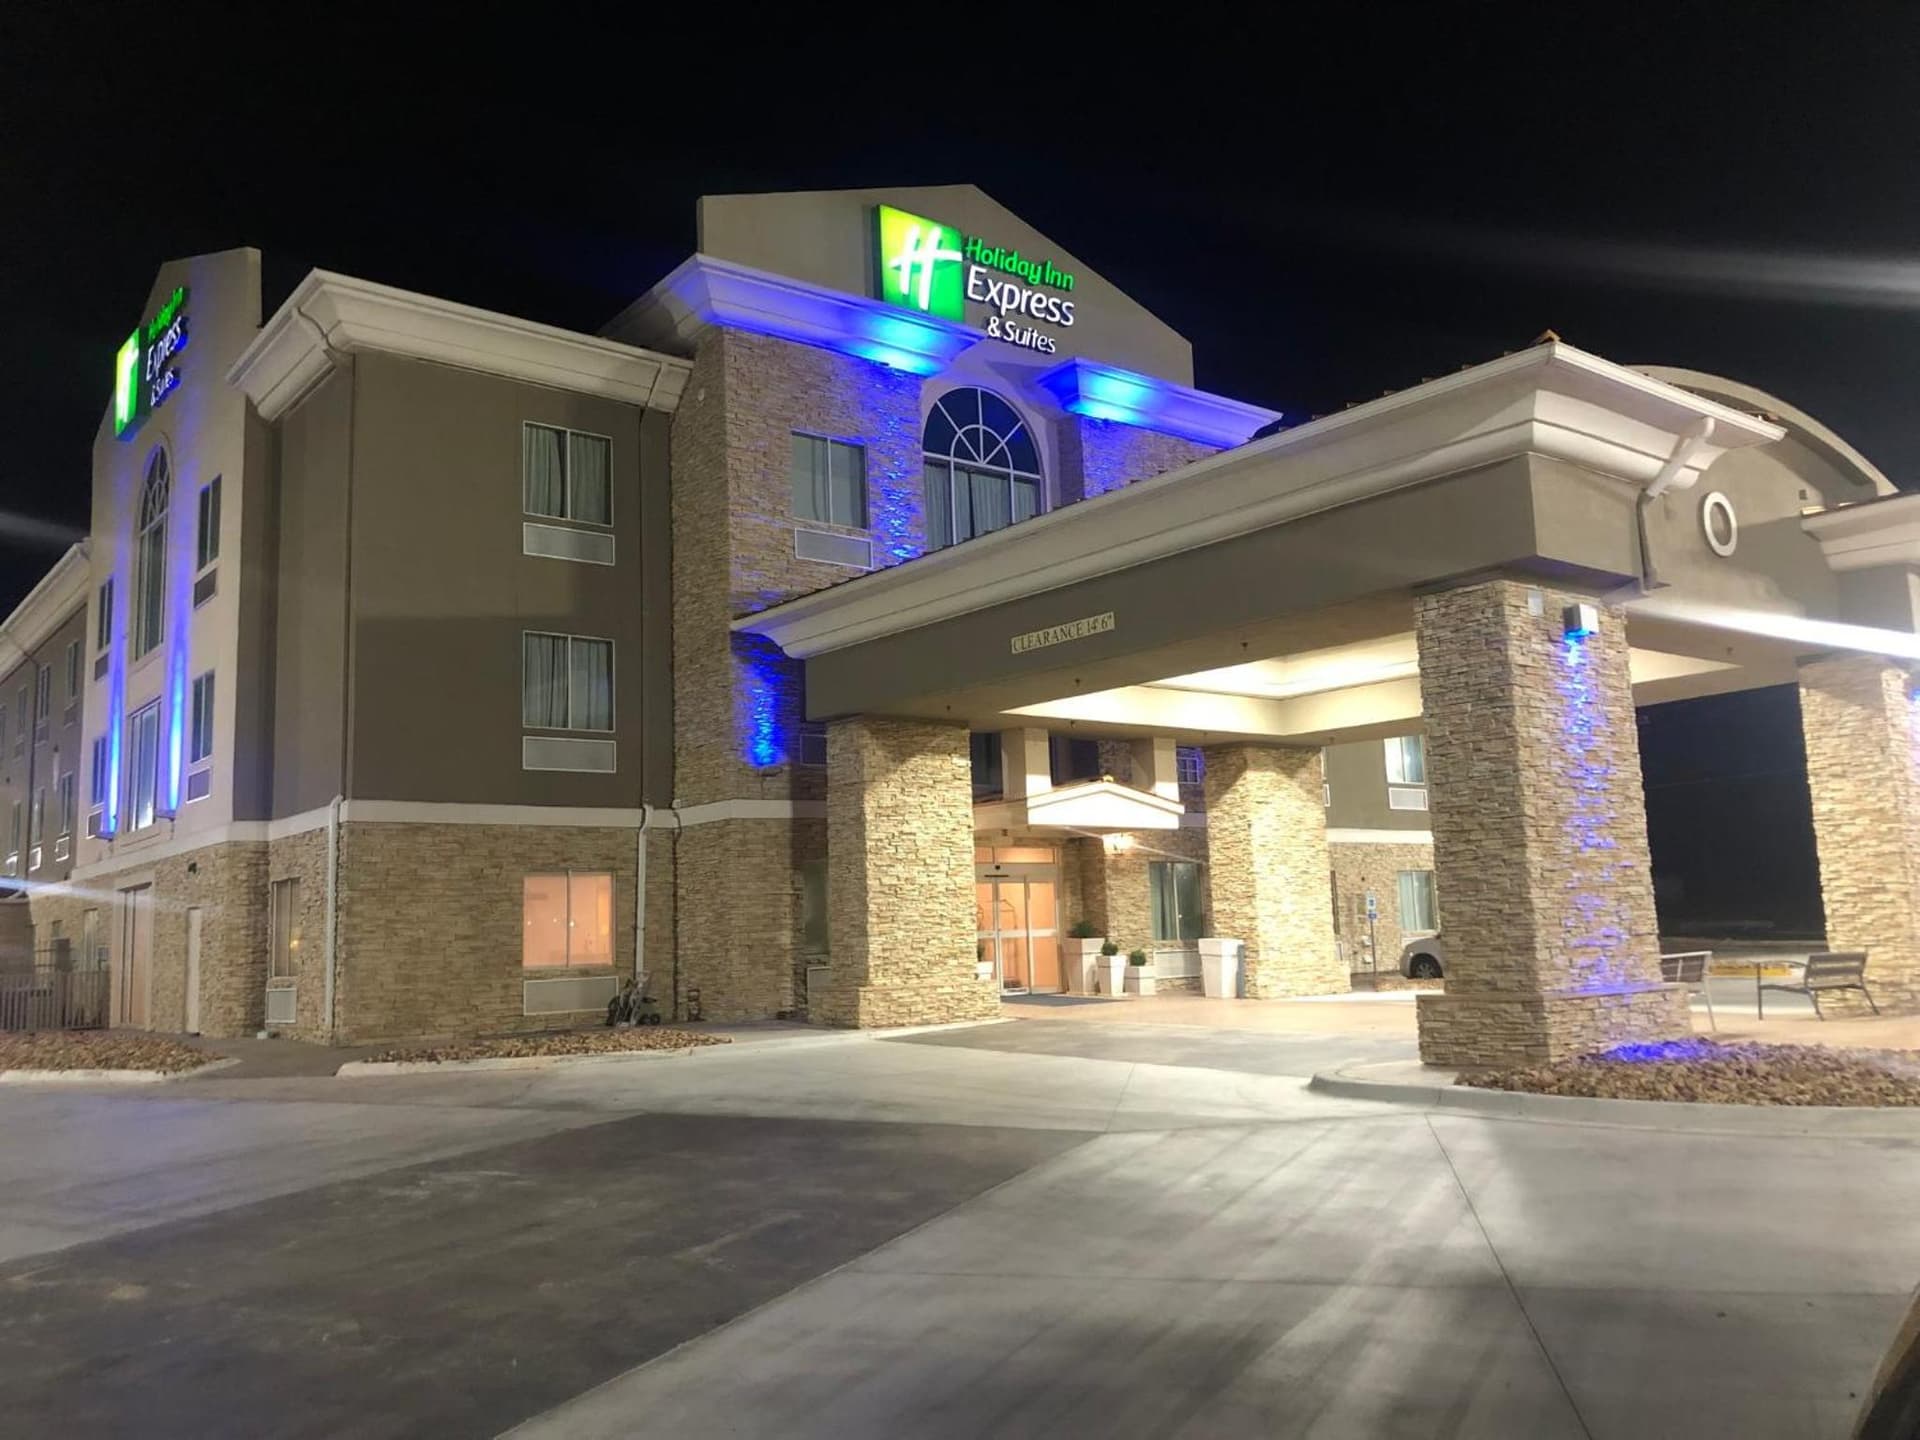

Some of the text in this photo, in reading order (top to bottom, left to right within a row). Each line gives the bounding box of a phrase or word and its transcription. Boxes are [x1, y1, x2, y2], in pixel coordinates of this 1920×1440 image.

[965, 236, 1074, 290] Holiday Inn
[967, 264, 1075, 326] Express
[987, 316, 1056, 353] & Suites
[1013, 622, 1083, 652] CLEARANCE
